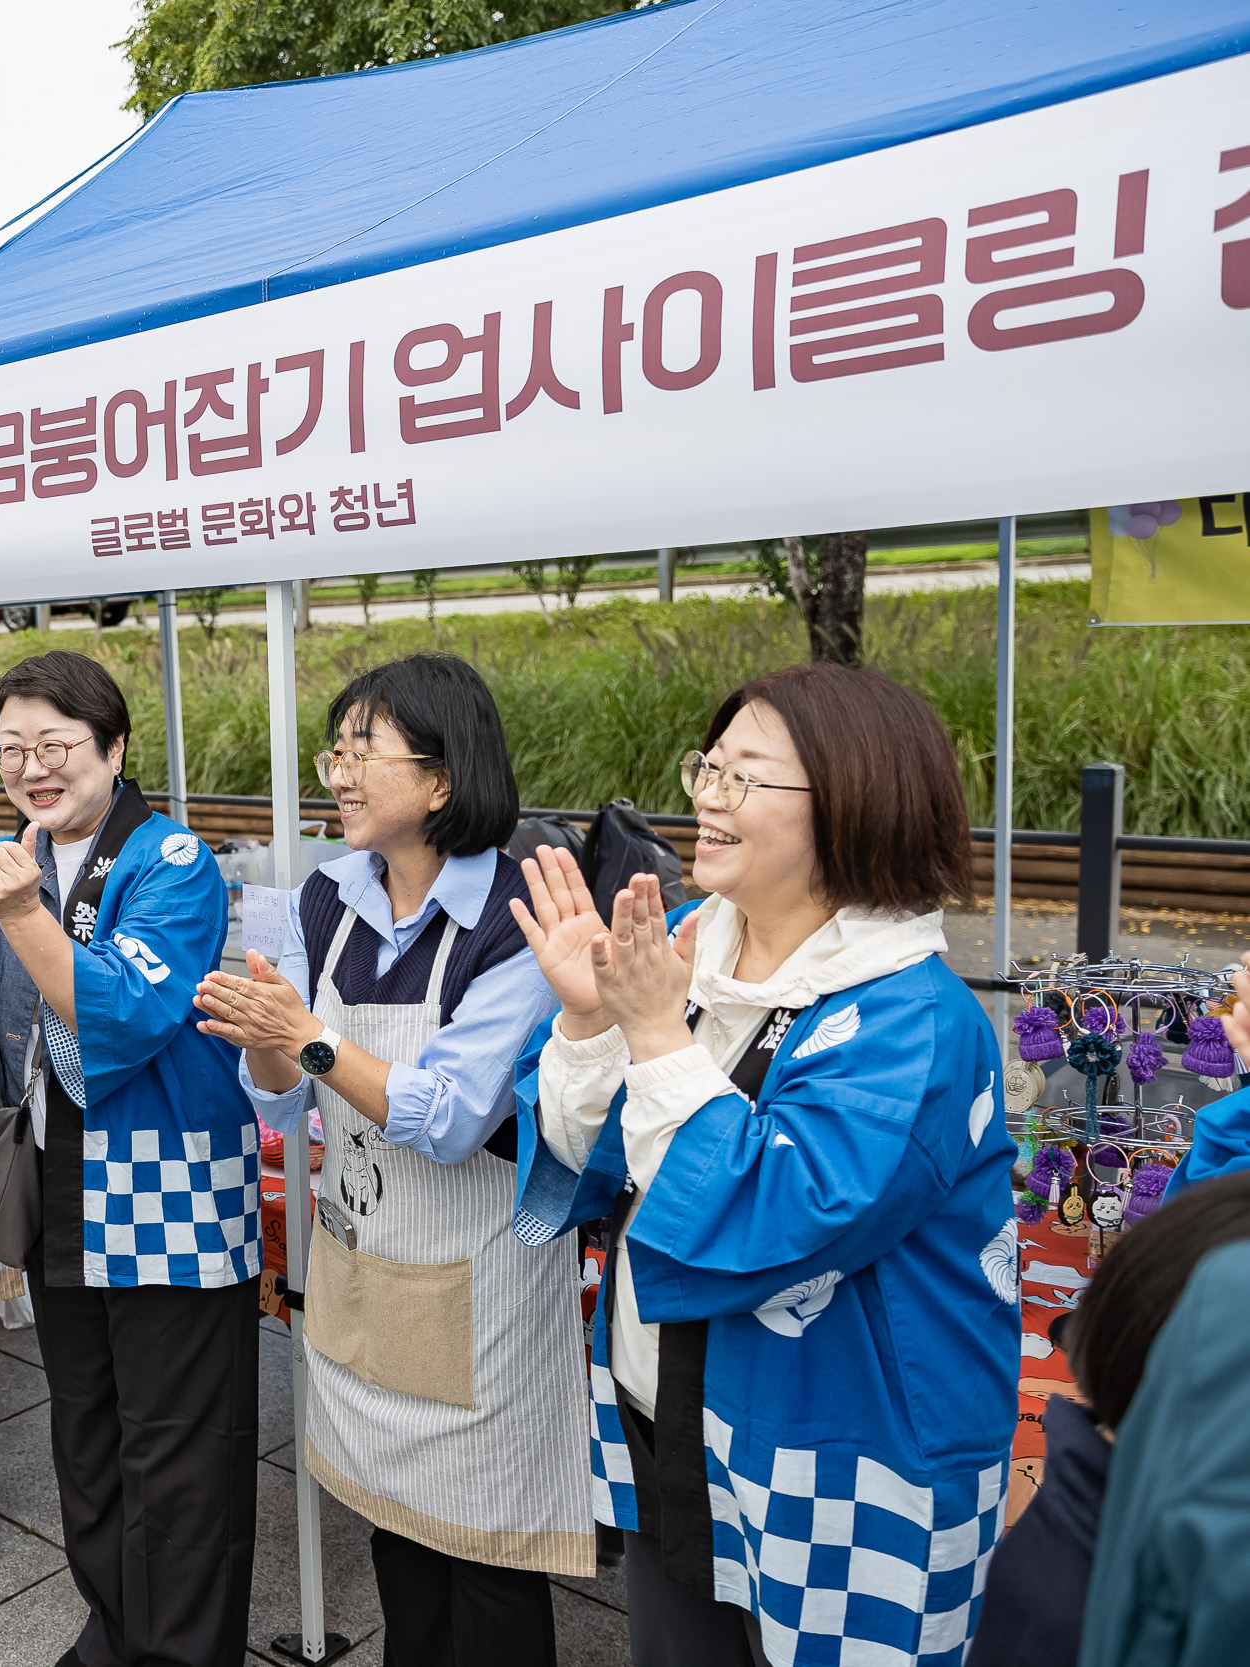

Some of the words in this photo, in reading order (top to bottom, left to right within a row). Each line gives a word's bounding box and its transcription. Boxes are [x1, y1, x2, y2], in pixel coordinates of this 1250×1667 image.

[393, 168, 1150, 445] 업사이클링
[90, 507, 191, 557] 글로벌
[201, 492, 317, 546] 문화와
[329, 478, 417, 533] 청년
[247, 933, 275, 947] KIMURA
